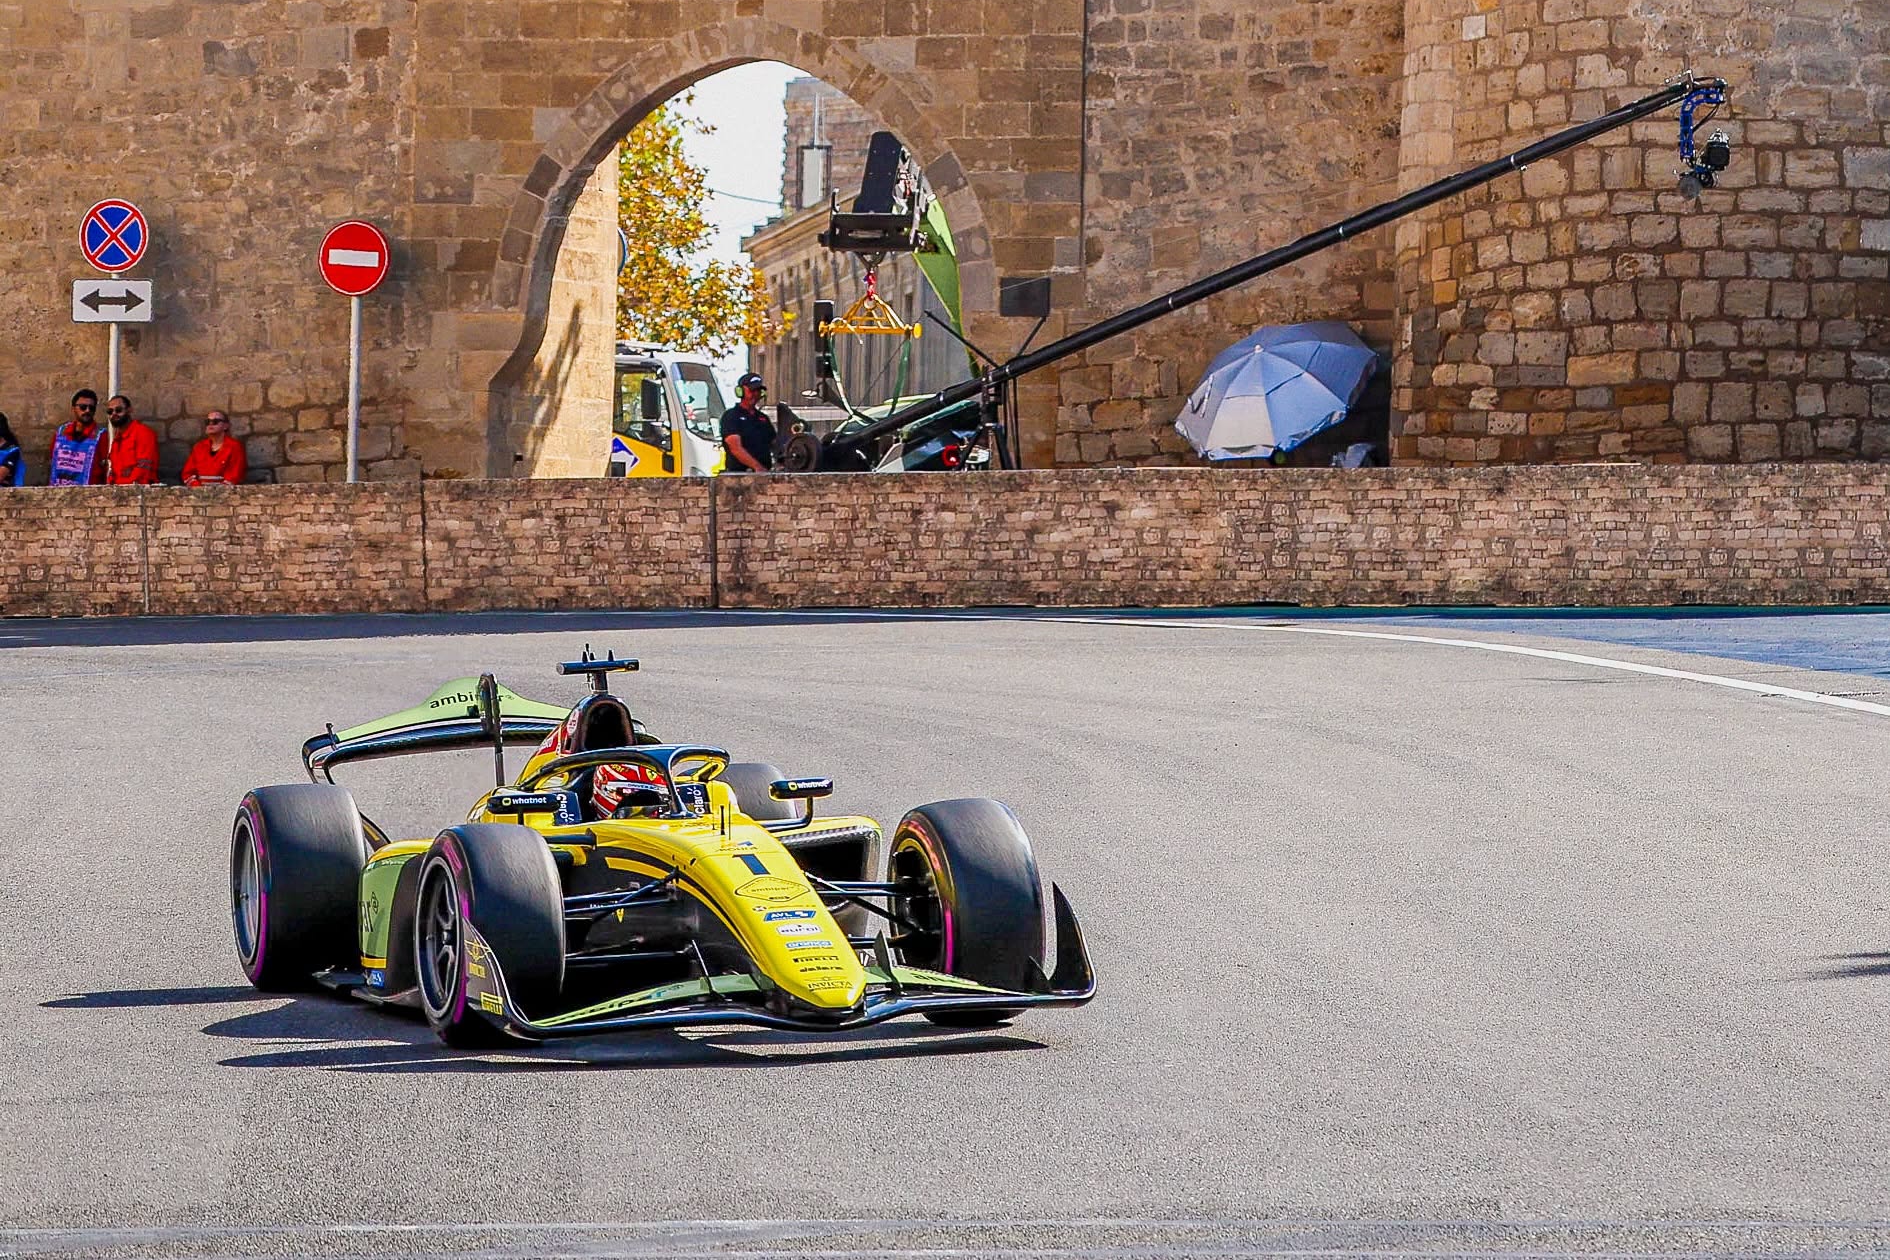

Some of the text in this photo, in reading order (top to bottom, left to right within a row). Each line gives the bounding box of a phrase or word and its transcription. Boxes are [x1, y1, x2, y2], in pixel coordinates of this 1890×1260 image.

[512, 796, 547, 805] whatnot
[732, 853, 770, 875] 1
[807, 980, 853, 989] INVICTA
